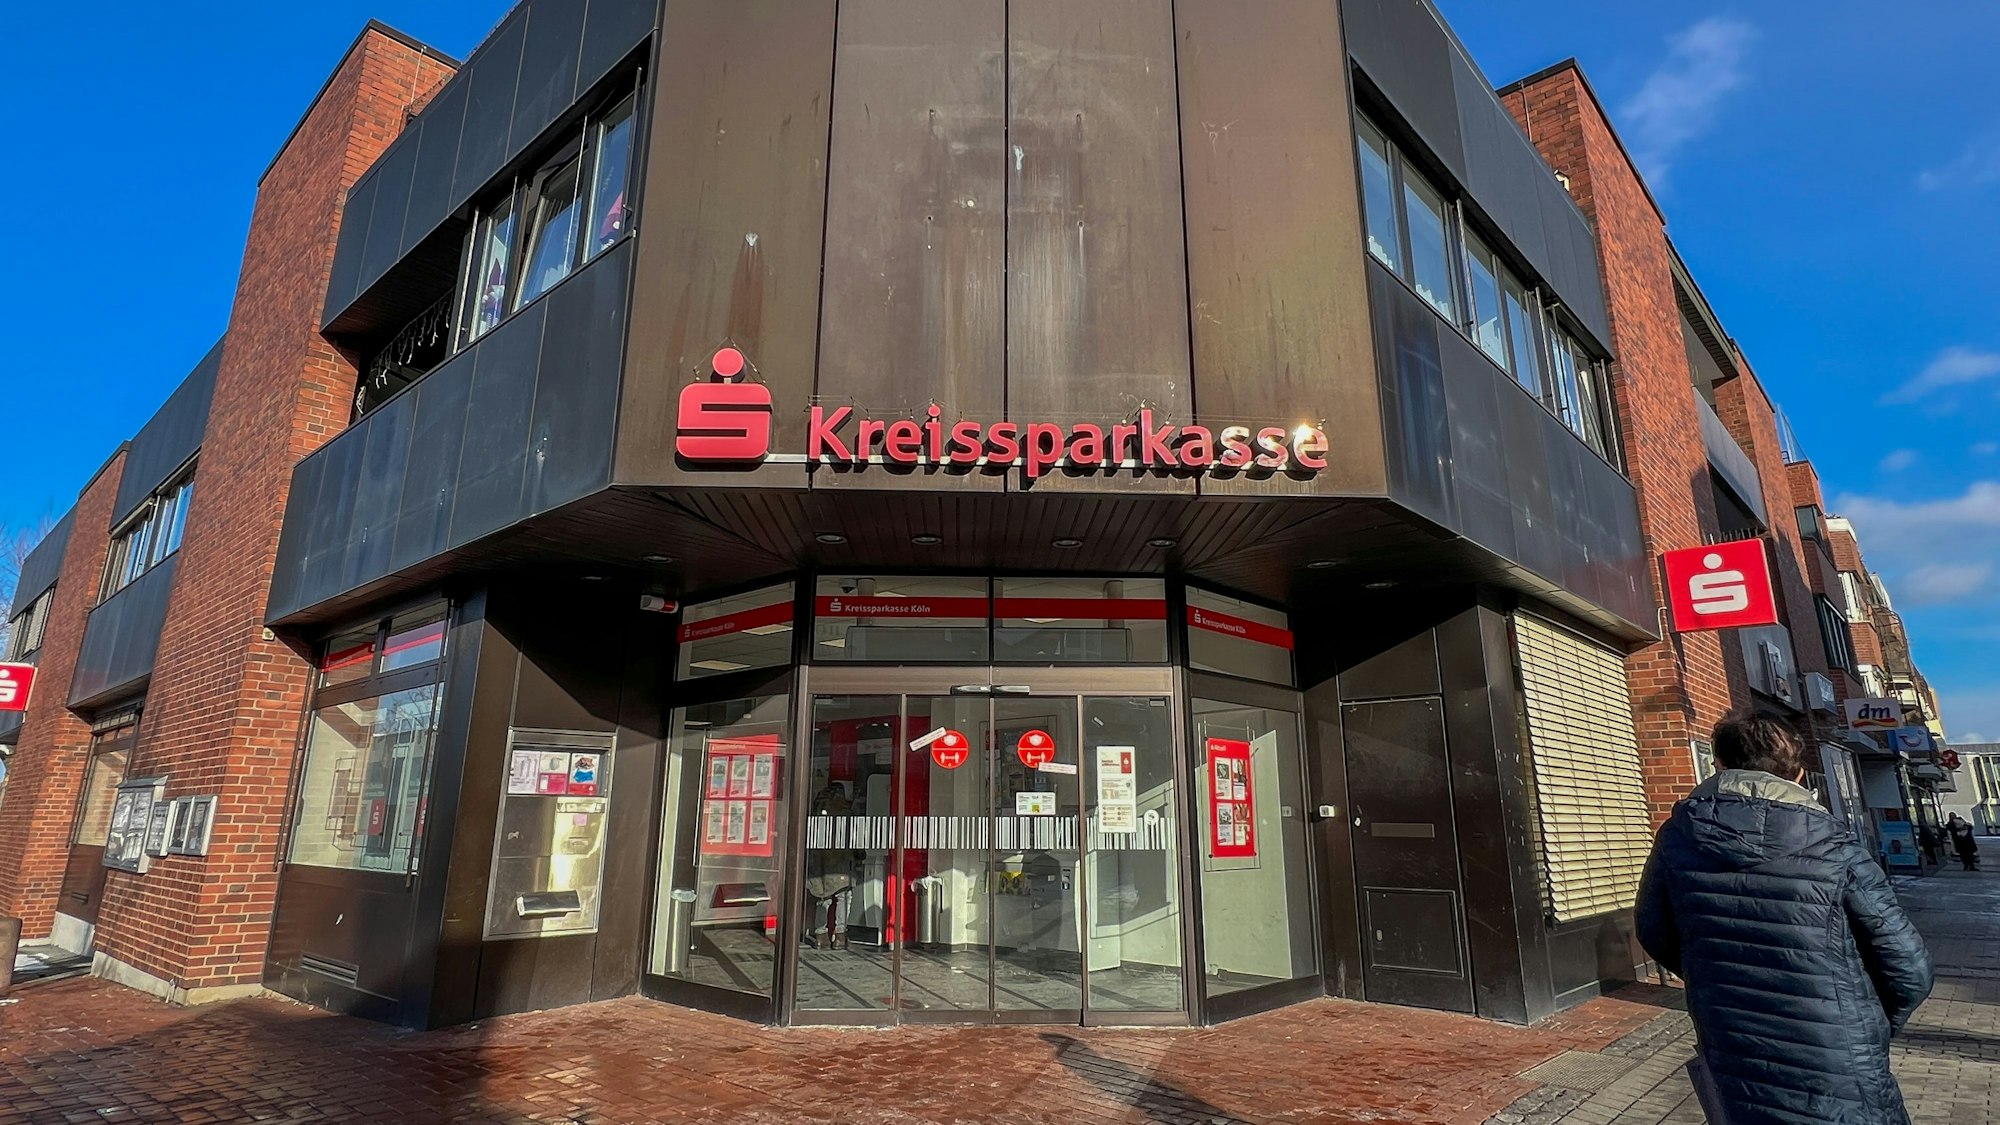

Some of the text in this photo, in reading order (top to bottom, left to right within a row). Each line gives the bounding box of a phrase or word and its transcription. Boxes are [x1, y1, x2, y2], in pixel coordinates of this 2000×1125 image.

[808, 405, 1329, 478] Kreissparkasse
[845, 604, 930, 614] Kreissparkasse Köln
[1858, 703, 1891, 719] dm
